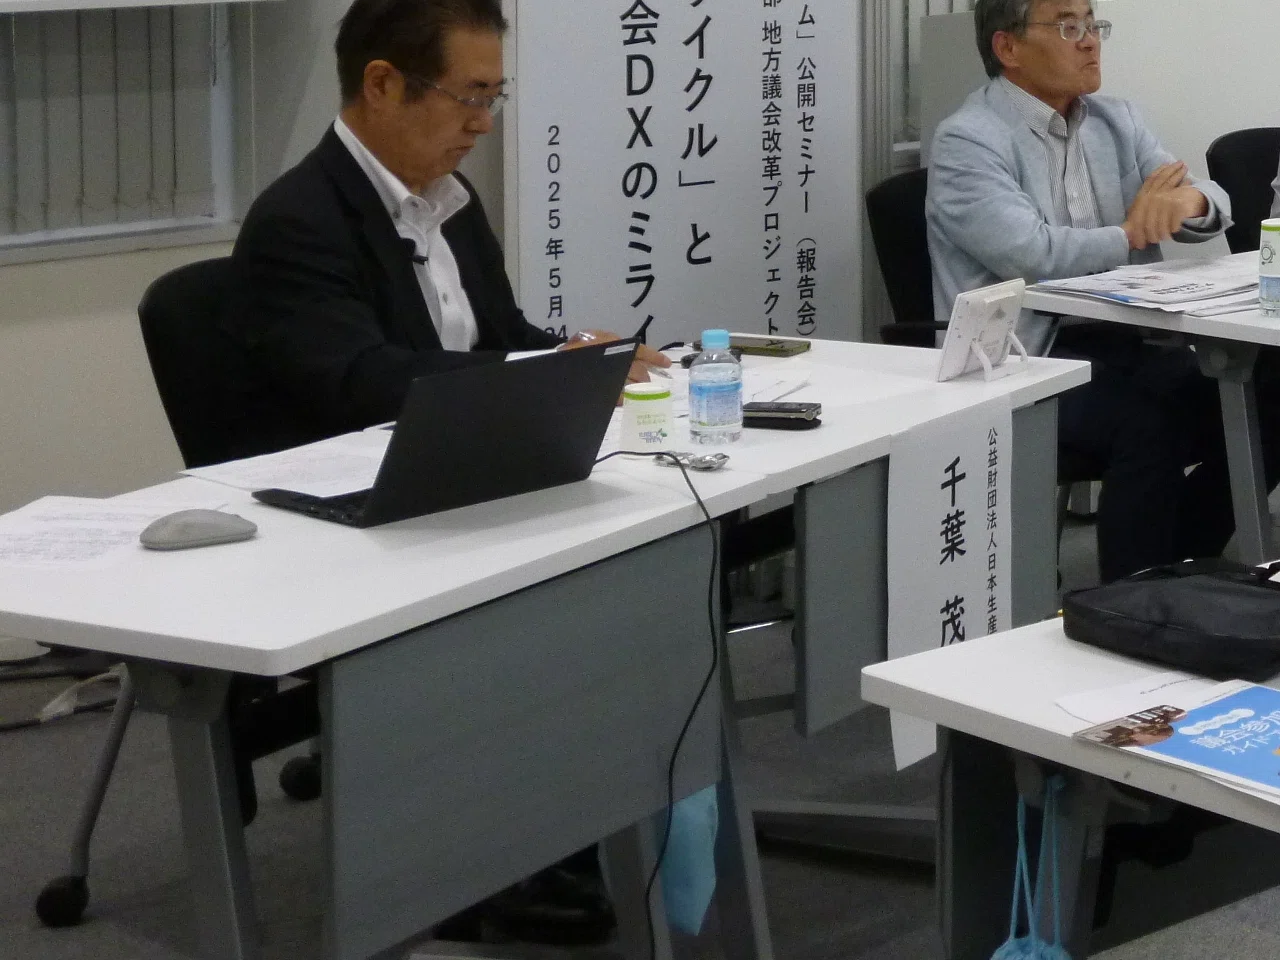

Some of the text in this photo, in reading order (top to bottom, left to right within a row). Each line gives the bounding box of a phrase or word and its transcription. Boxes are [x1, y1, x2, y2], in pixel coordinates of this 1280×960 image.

[761, 20, 783, 335] 地方議会改革プロジェクト
[939, 455, 967, 565] 千葉
